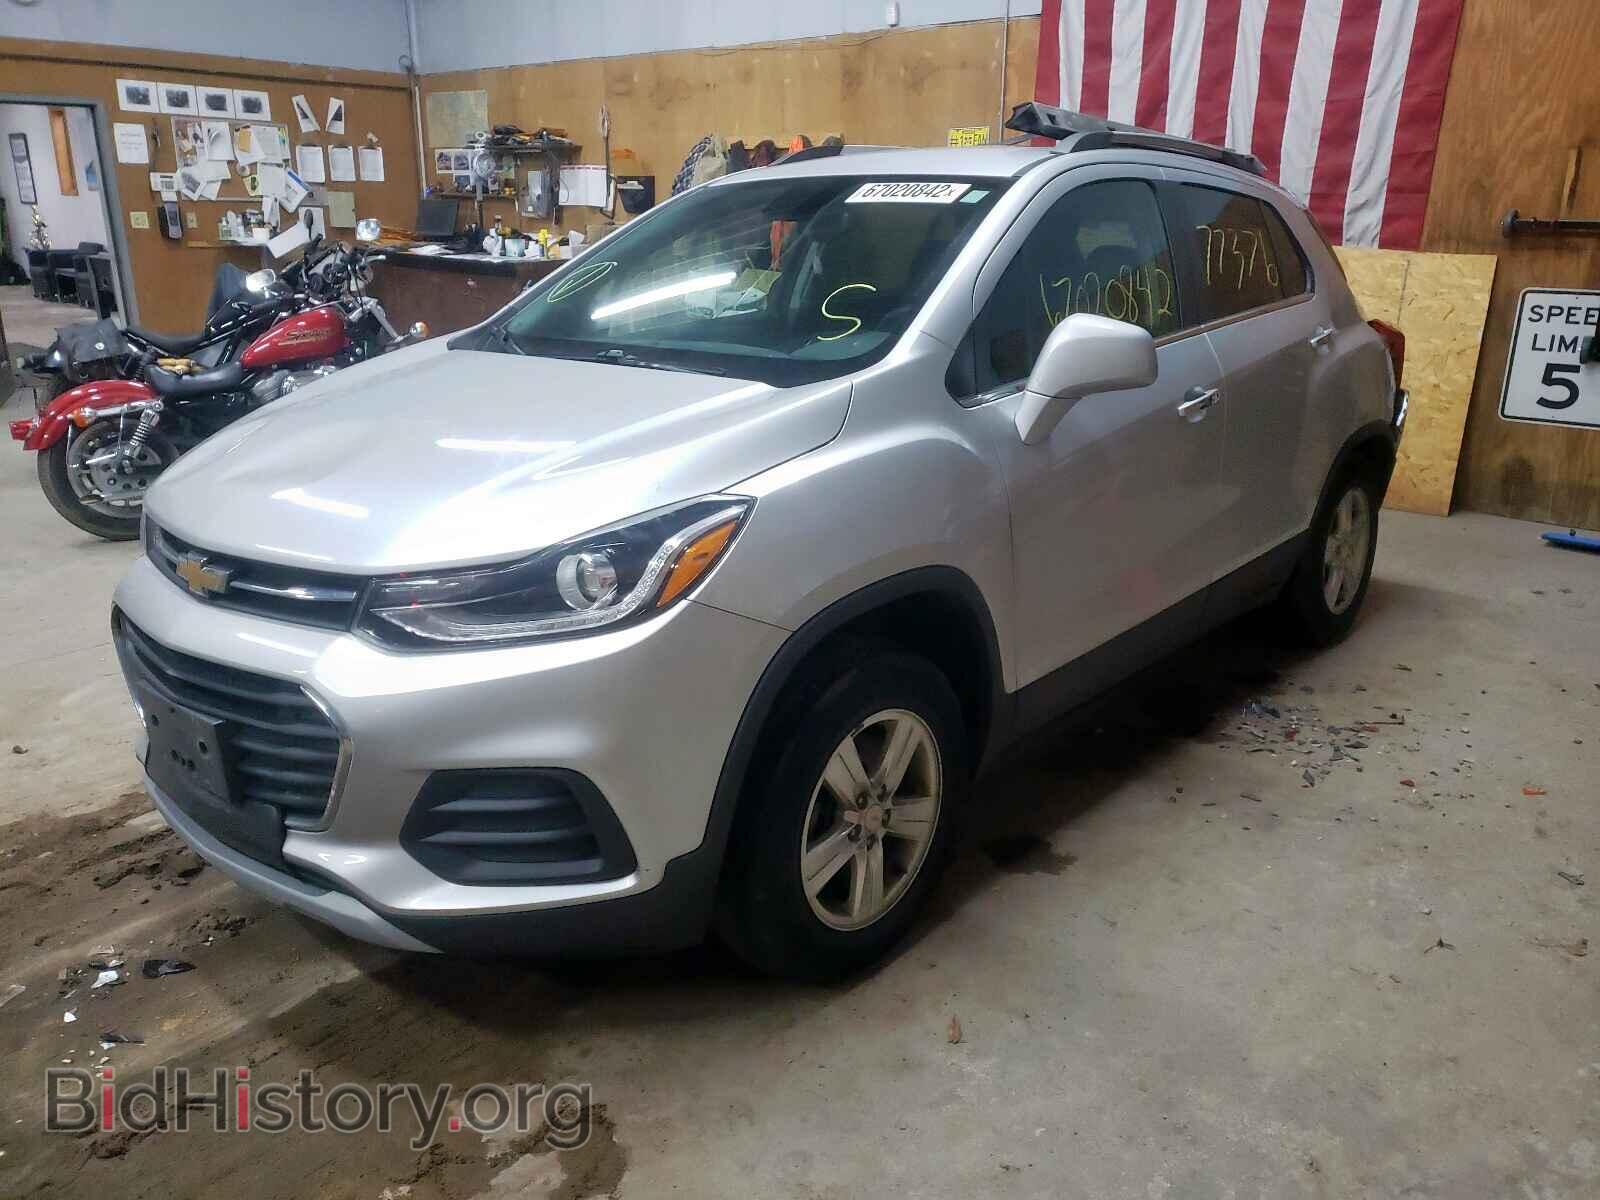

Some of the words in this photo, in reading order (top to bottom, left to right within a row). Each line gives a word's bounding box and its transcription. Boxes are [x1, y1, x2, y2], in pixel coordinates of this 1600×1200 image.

[1528, 304, 1600, 326] SPEE
[1531, 333, 1581, 354] LIM
[1536, 362, 1581, 410] 5
